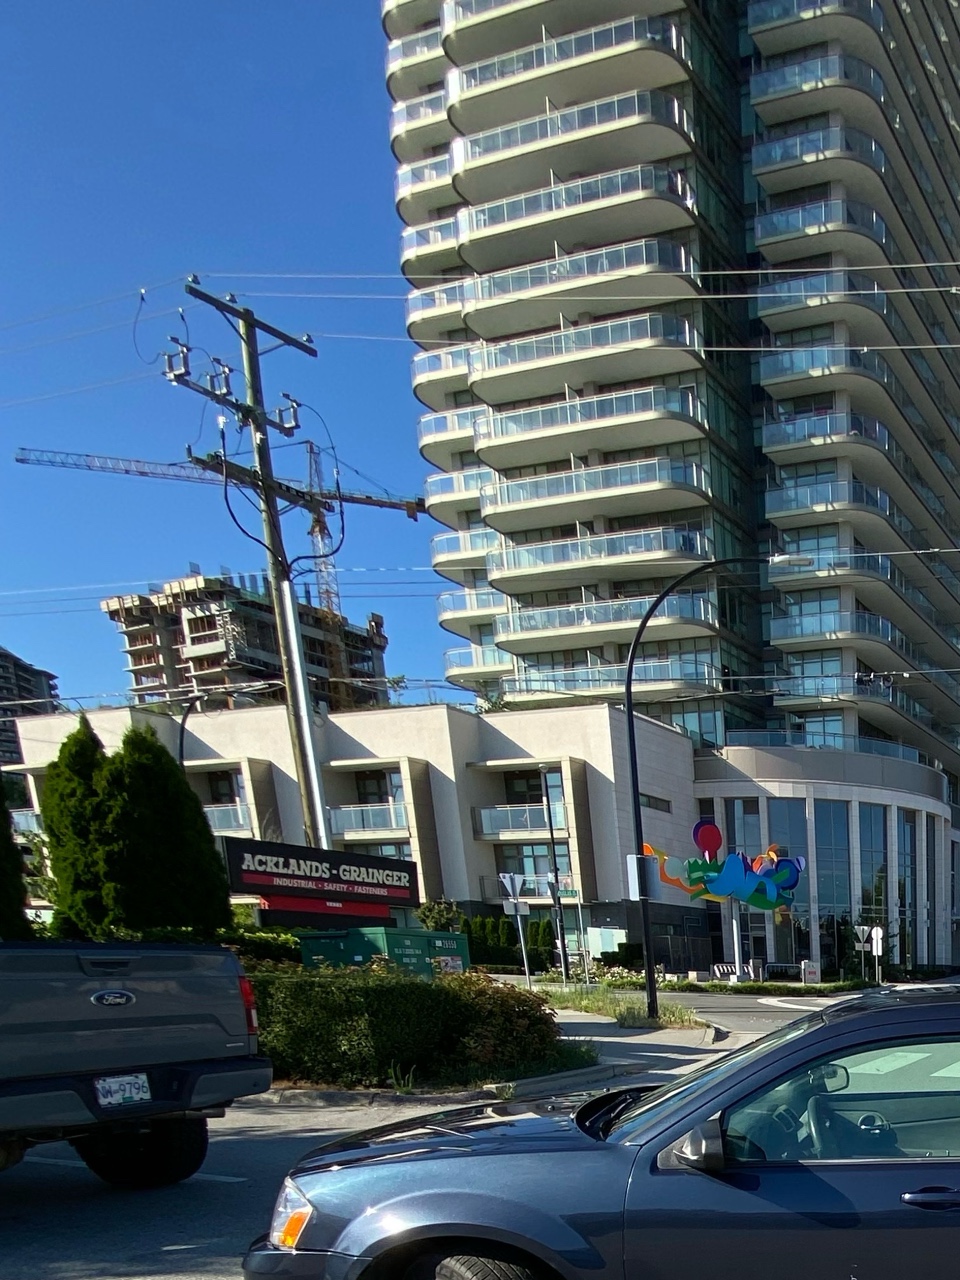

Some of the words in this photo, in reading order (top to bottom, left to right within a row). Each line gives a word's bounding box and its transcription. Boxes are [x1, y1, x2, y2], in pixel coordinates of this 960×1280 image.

[273, 877, 317, 890] INDUSTRIAL
[324, 882, 348, 892] SAFETY
[354, 885, 388, 896] FASTENERS
[103, 994, 126, 1004] Ford
